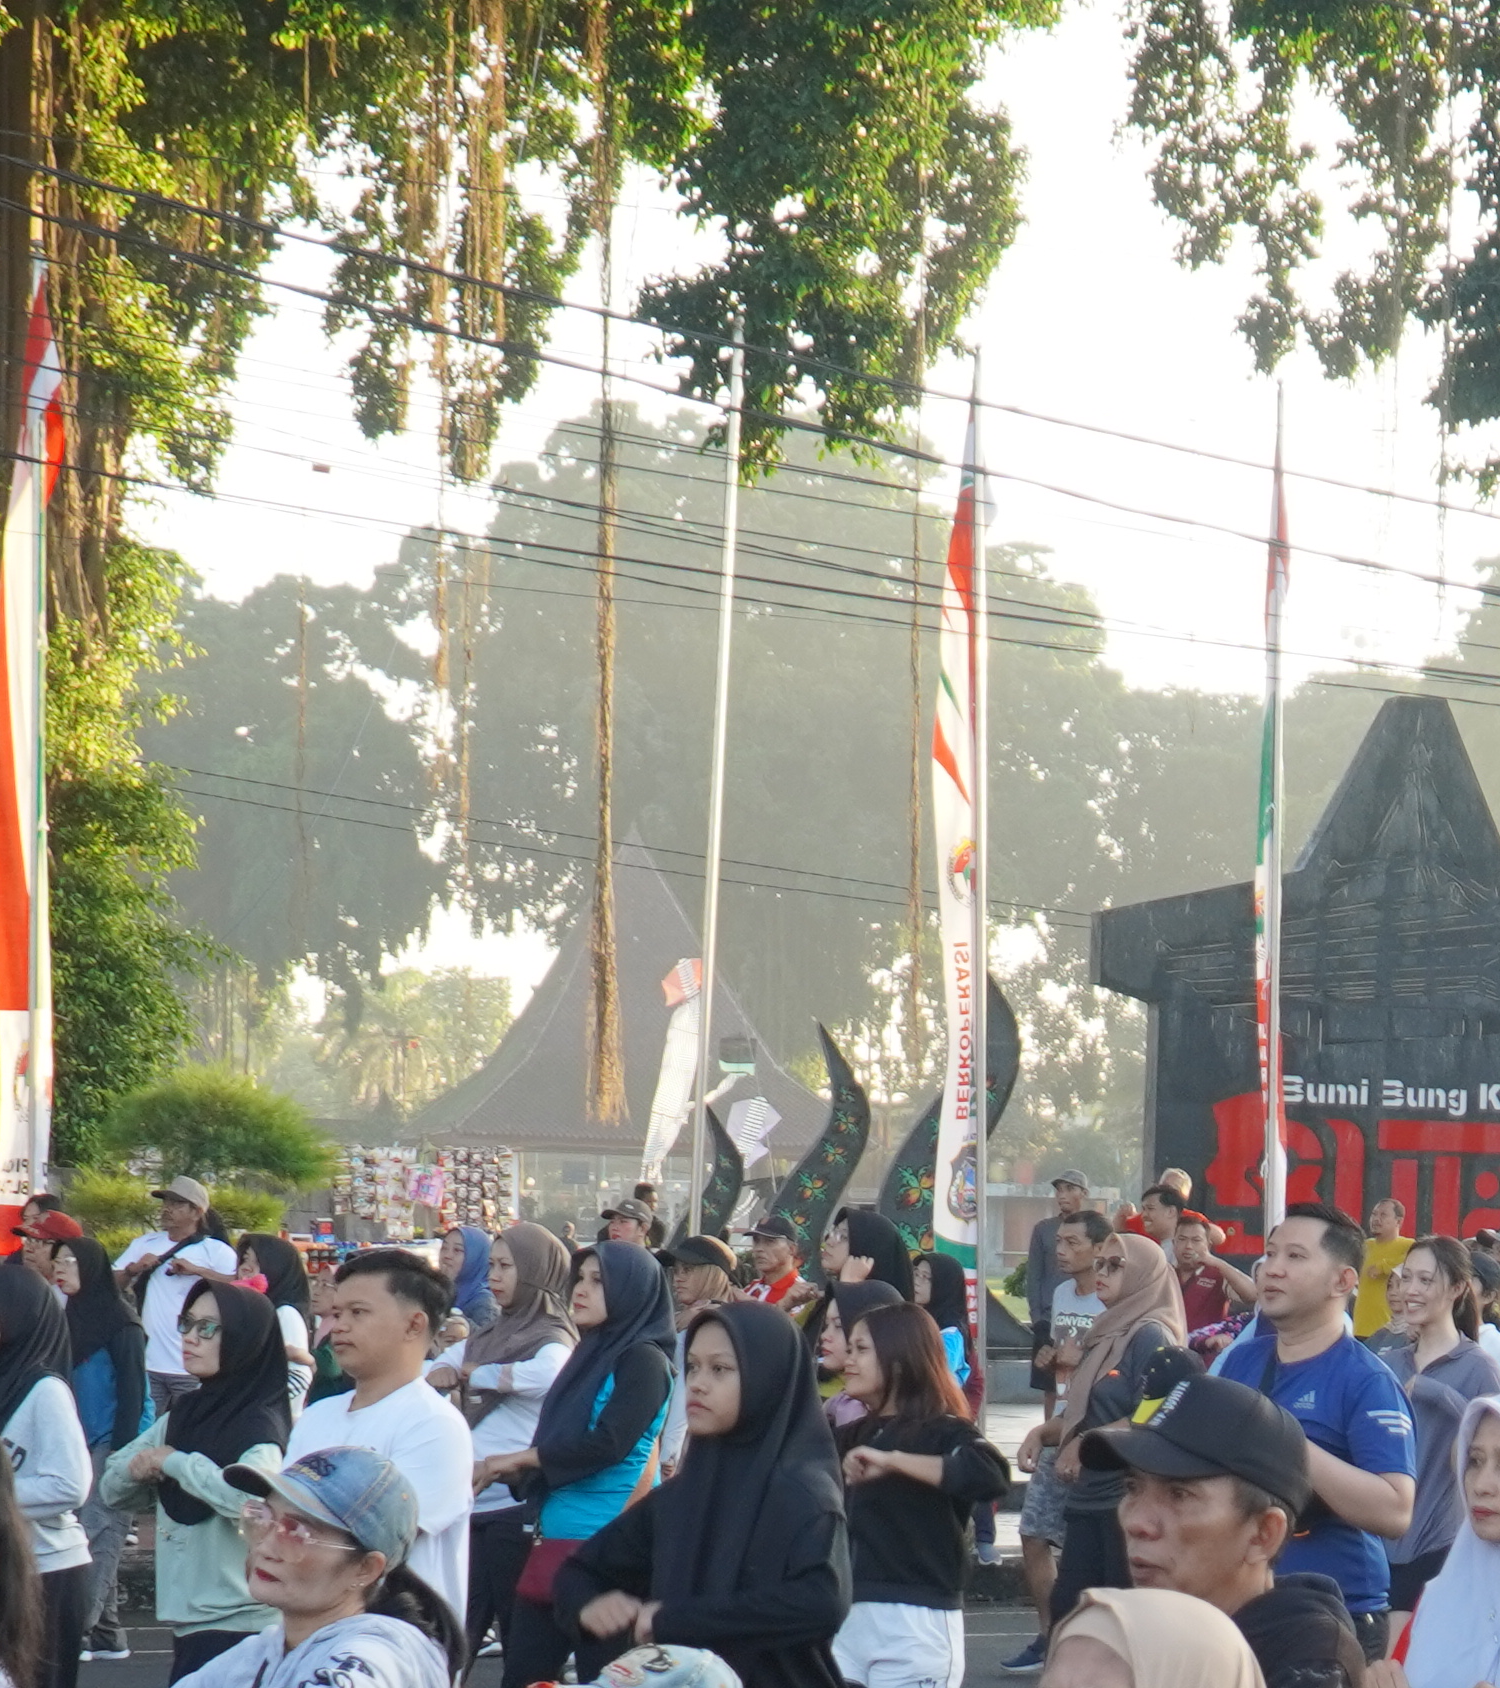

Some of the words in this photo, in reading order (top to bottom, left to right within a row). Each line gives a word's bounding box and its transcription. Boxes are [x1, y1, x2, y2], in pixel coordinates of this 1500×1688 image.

[1283, 1074, 1370, 1106] Bumi
[1381, 1079, 1468, 1116] Bung
[1054, 1315, 1094, 1329] CONVERS
